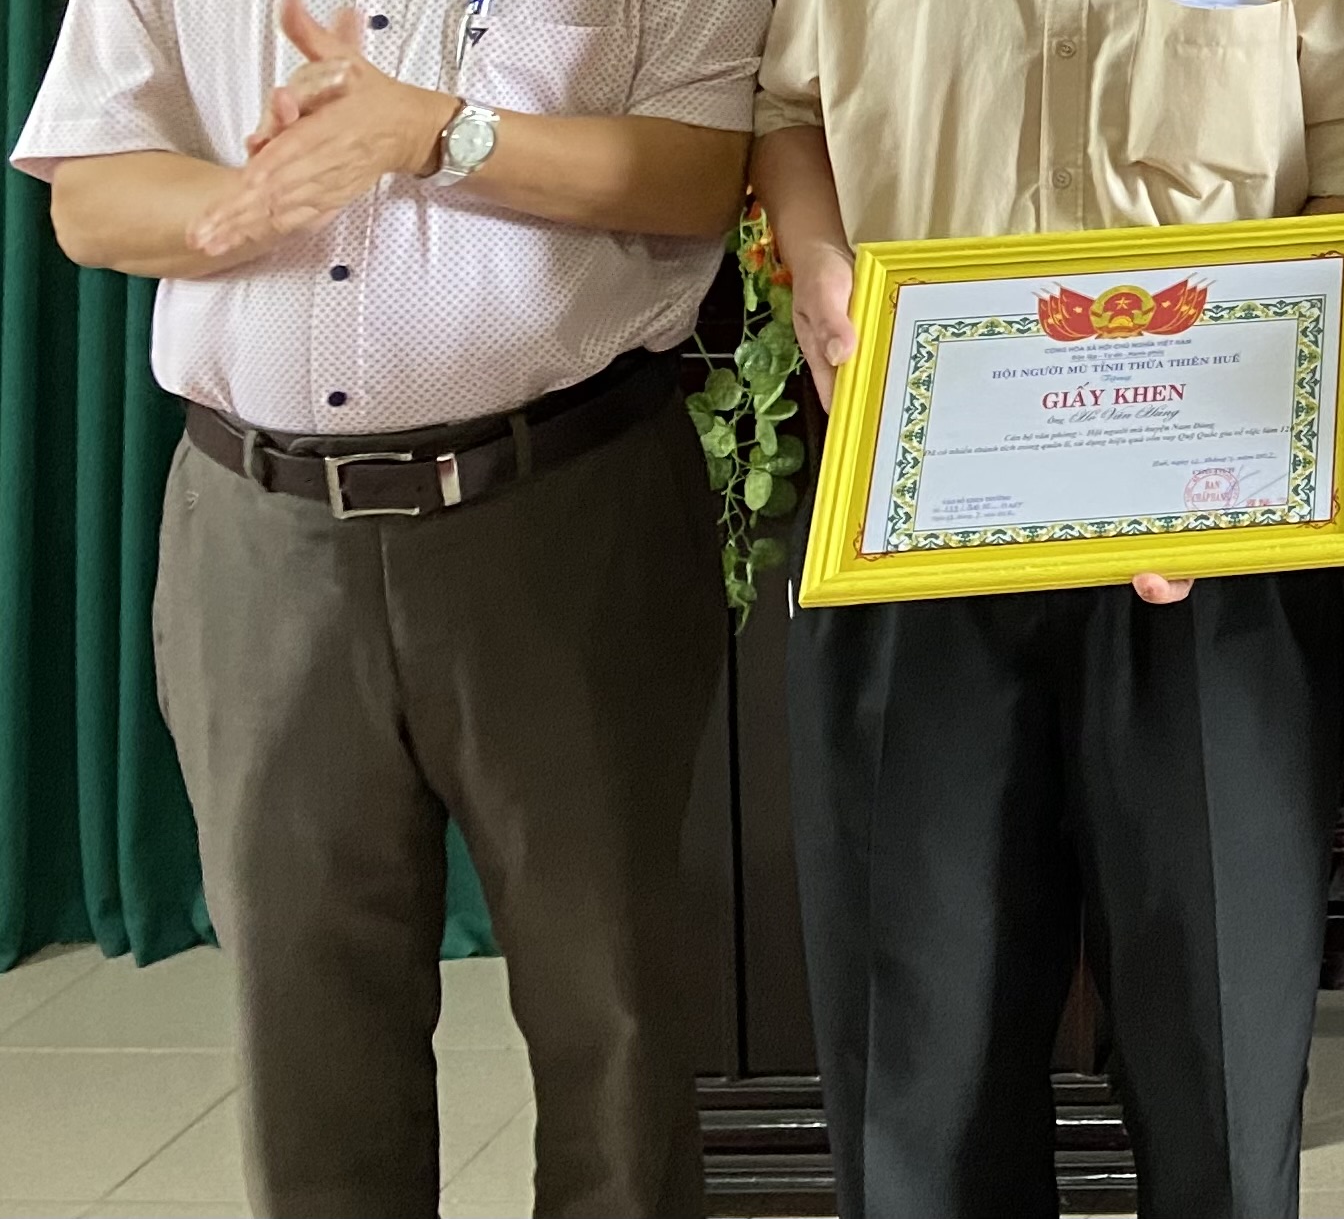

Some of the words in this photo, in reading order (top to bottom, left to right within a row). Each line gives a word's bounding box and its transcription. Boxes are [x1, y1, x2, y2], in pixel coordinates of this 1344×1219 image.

[992, 368, 1016, 379] HỘI
[1021, 366, 1063, 377] NGƯỜI
[1067, 365, 1087, 374] MÙ
[1168, 356, 1209, 367] THIÊN
[1042, 382, 1104, 409] GIẤY
[1114, 384, 1185, 404] KHEN
